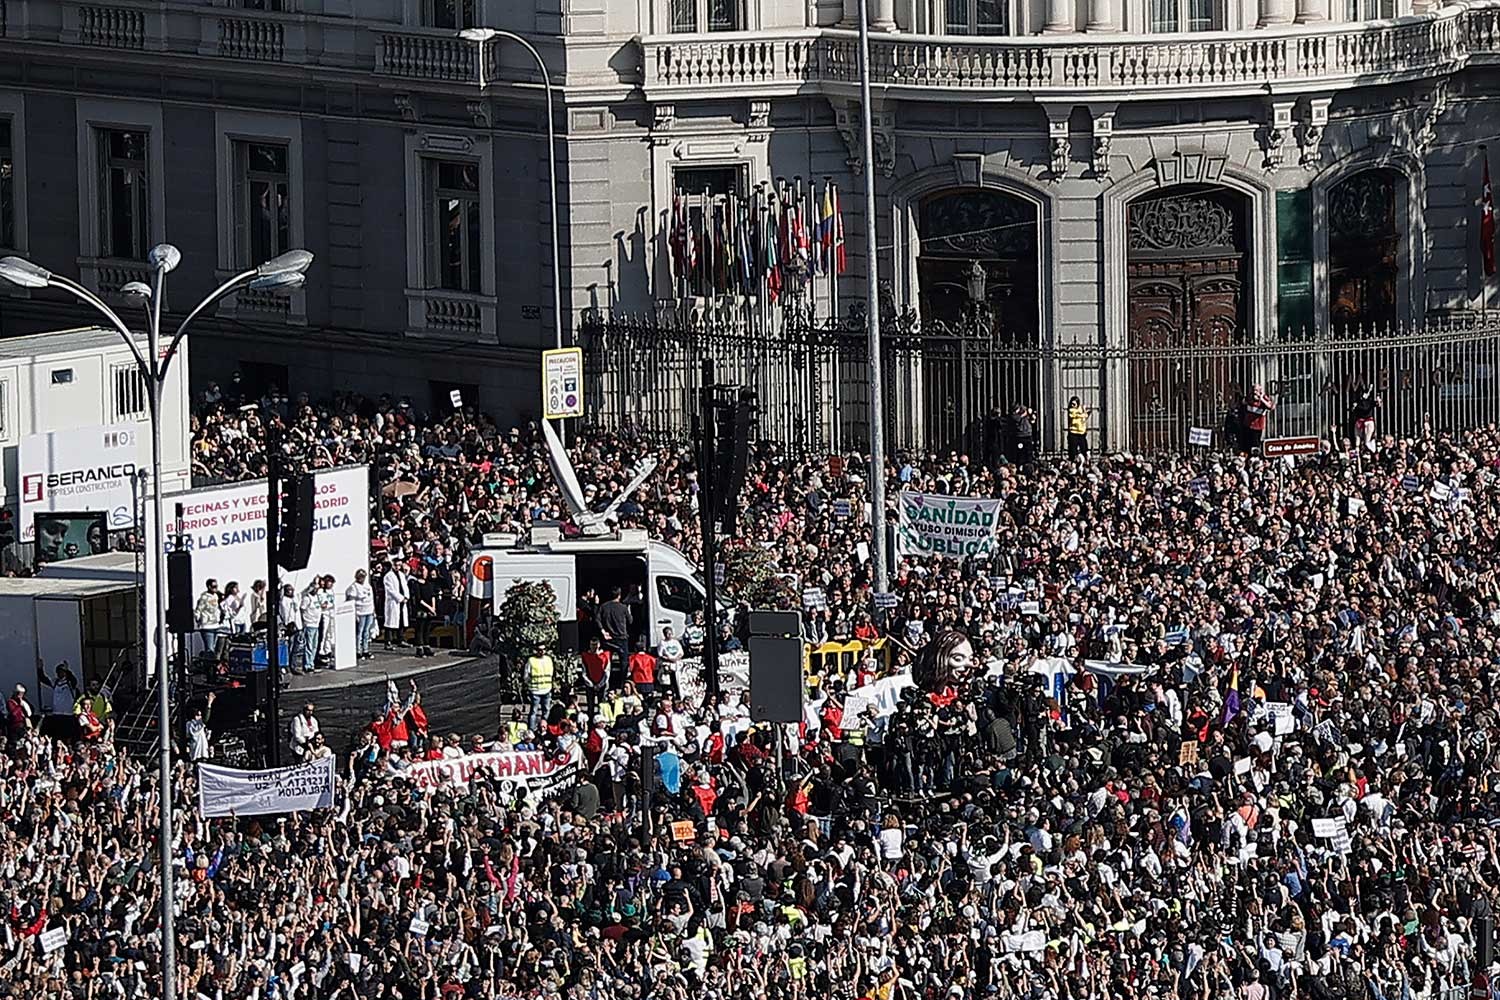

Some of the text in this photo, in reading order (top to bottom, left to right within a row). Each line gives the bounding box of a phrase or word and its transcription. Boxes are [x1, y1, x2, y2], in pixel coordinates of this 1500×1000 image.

[47, 463, 135, 488] SERANCO
[47, 480, 122, 498] EMPRESA CONSTRUCTORA
[232, 499, 240, 509] Y
[166, 516, 217, 533] BRRIOS
[220, 515, 229, 525] Y
[906, 504, 994, 527] SANIDAD
[908, 522, 991, 538] AYUSO DIMISIÓN
[164, 538, 194, 554] PR
[199, 534, 217, 550] LA
